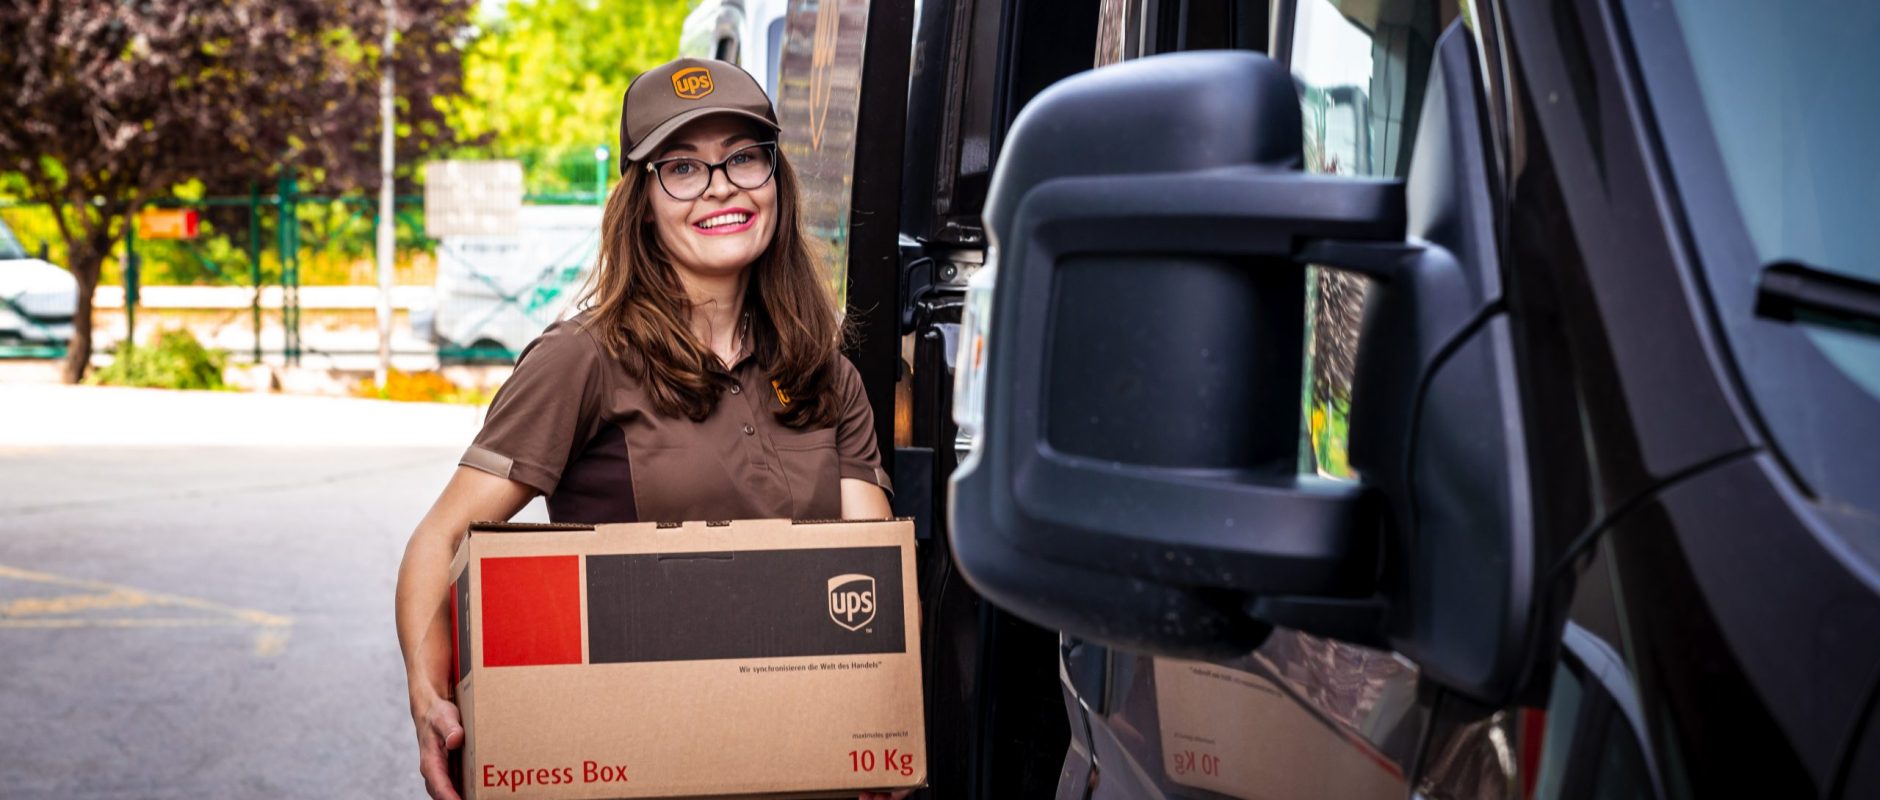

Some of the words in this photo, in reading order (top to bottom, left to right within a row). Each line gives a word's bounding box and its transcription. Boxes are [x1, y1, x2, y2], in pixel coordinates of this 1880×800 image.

[676, 74, 709, 94] ups
[832, 590, 872, 621] ups
[753, 664, 806, 674] synchronisieren
[820, 662, 836, 670] Welt
[483, 764, 573, 792] Express
[584, 760, 628, 783] Box
[848, 749, 874, 772] 10
[885, 748, 913, 776] Kg
